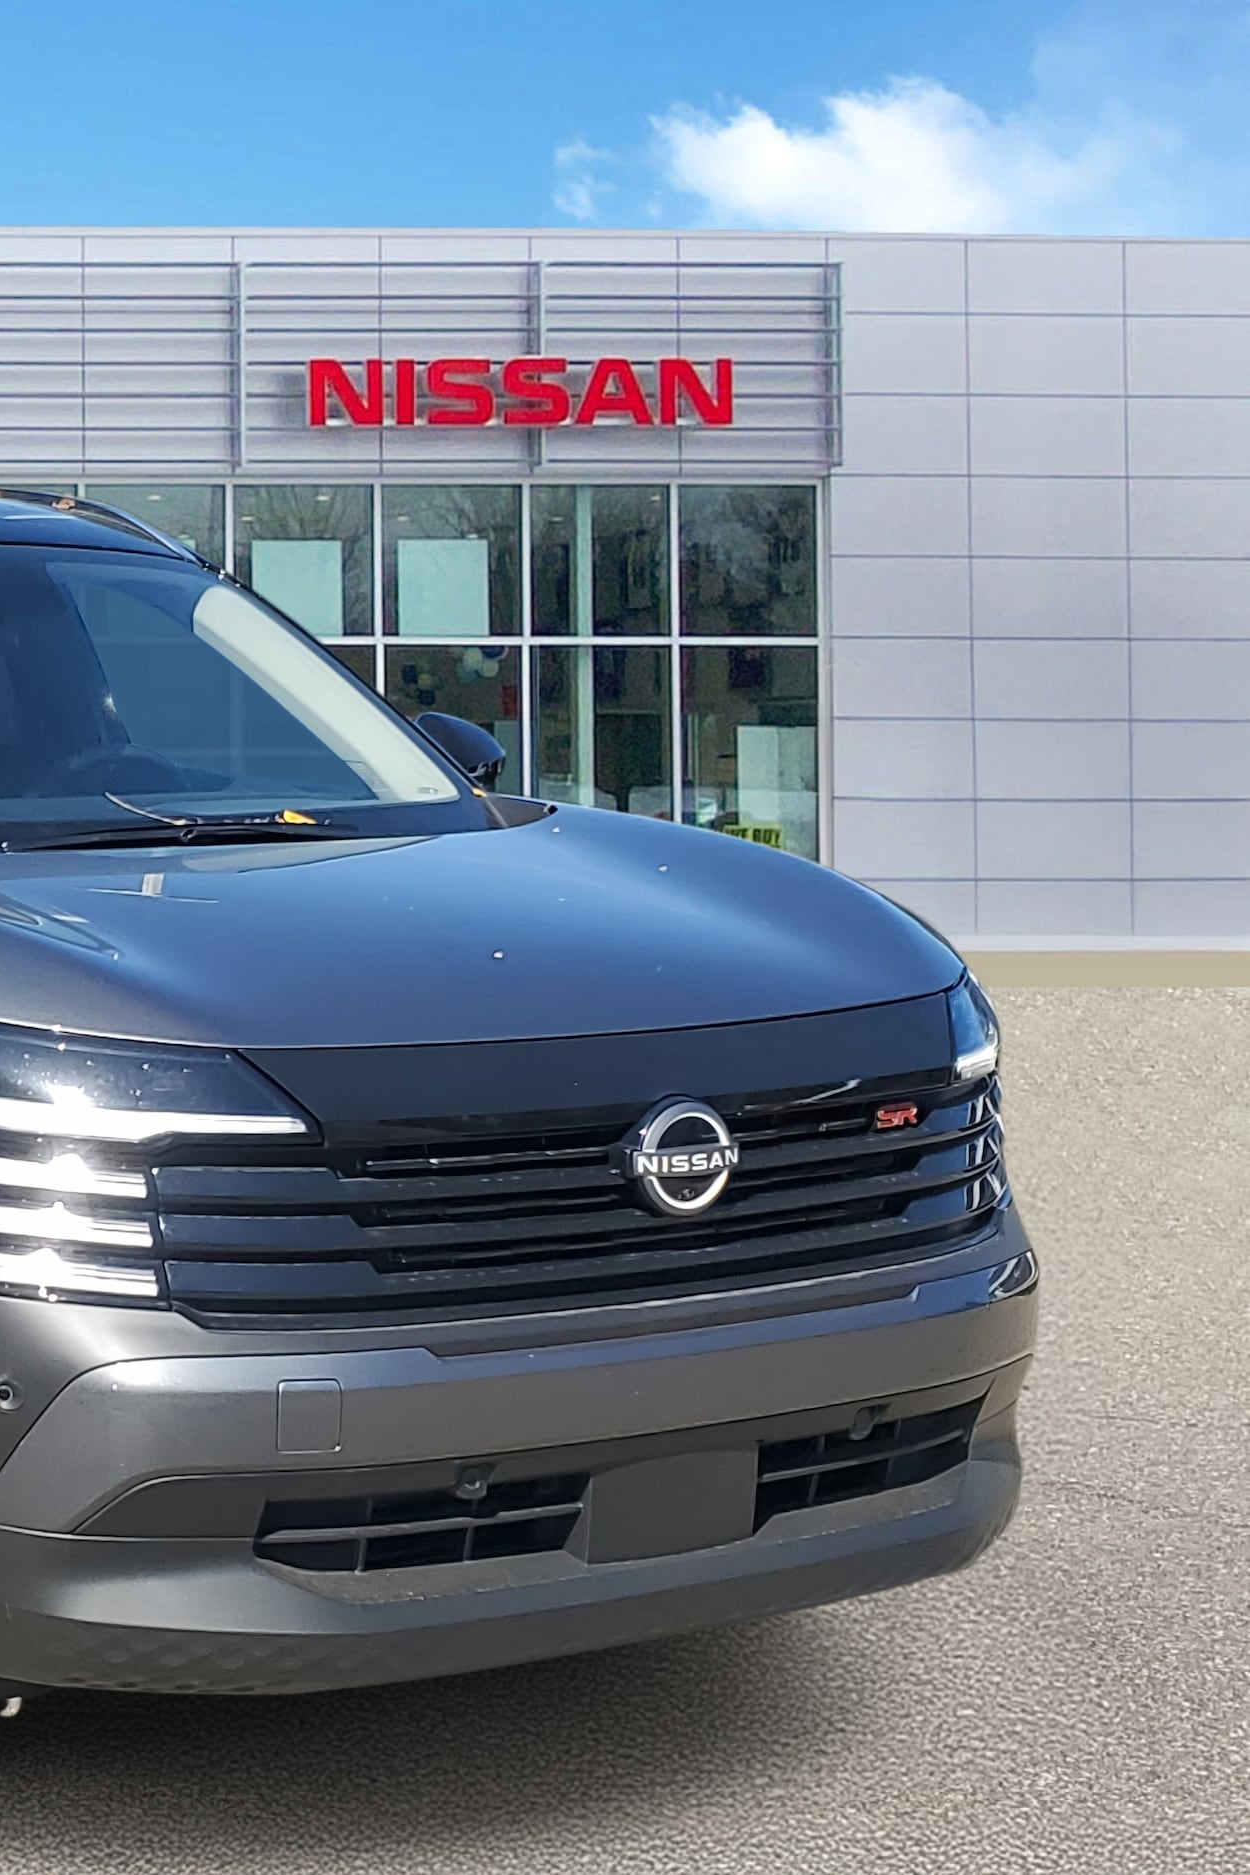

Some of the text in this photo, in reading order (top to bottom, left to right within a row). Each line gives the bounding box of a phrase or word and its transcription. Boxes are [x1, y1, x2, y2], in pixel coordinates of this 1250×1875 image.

[308, 357, 734, 426] NISSAN
[877, 1101, 918, 1130] SR
[637, 1148, 739, 1174] NISSAN
